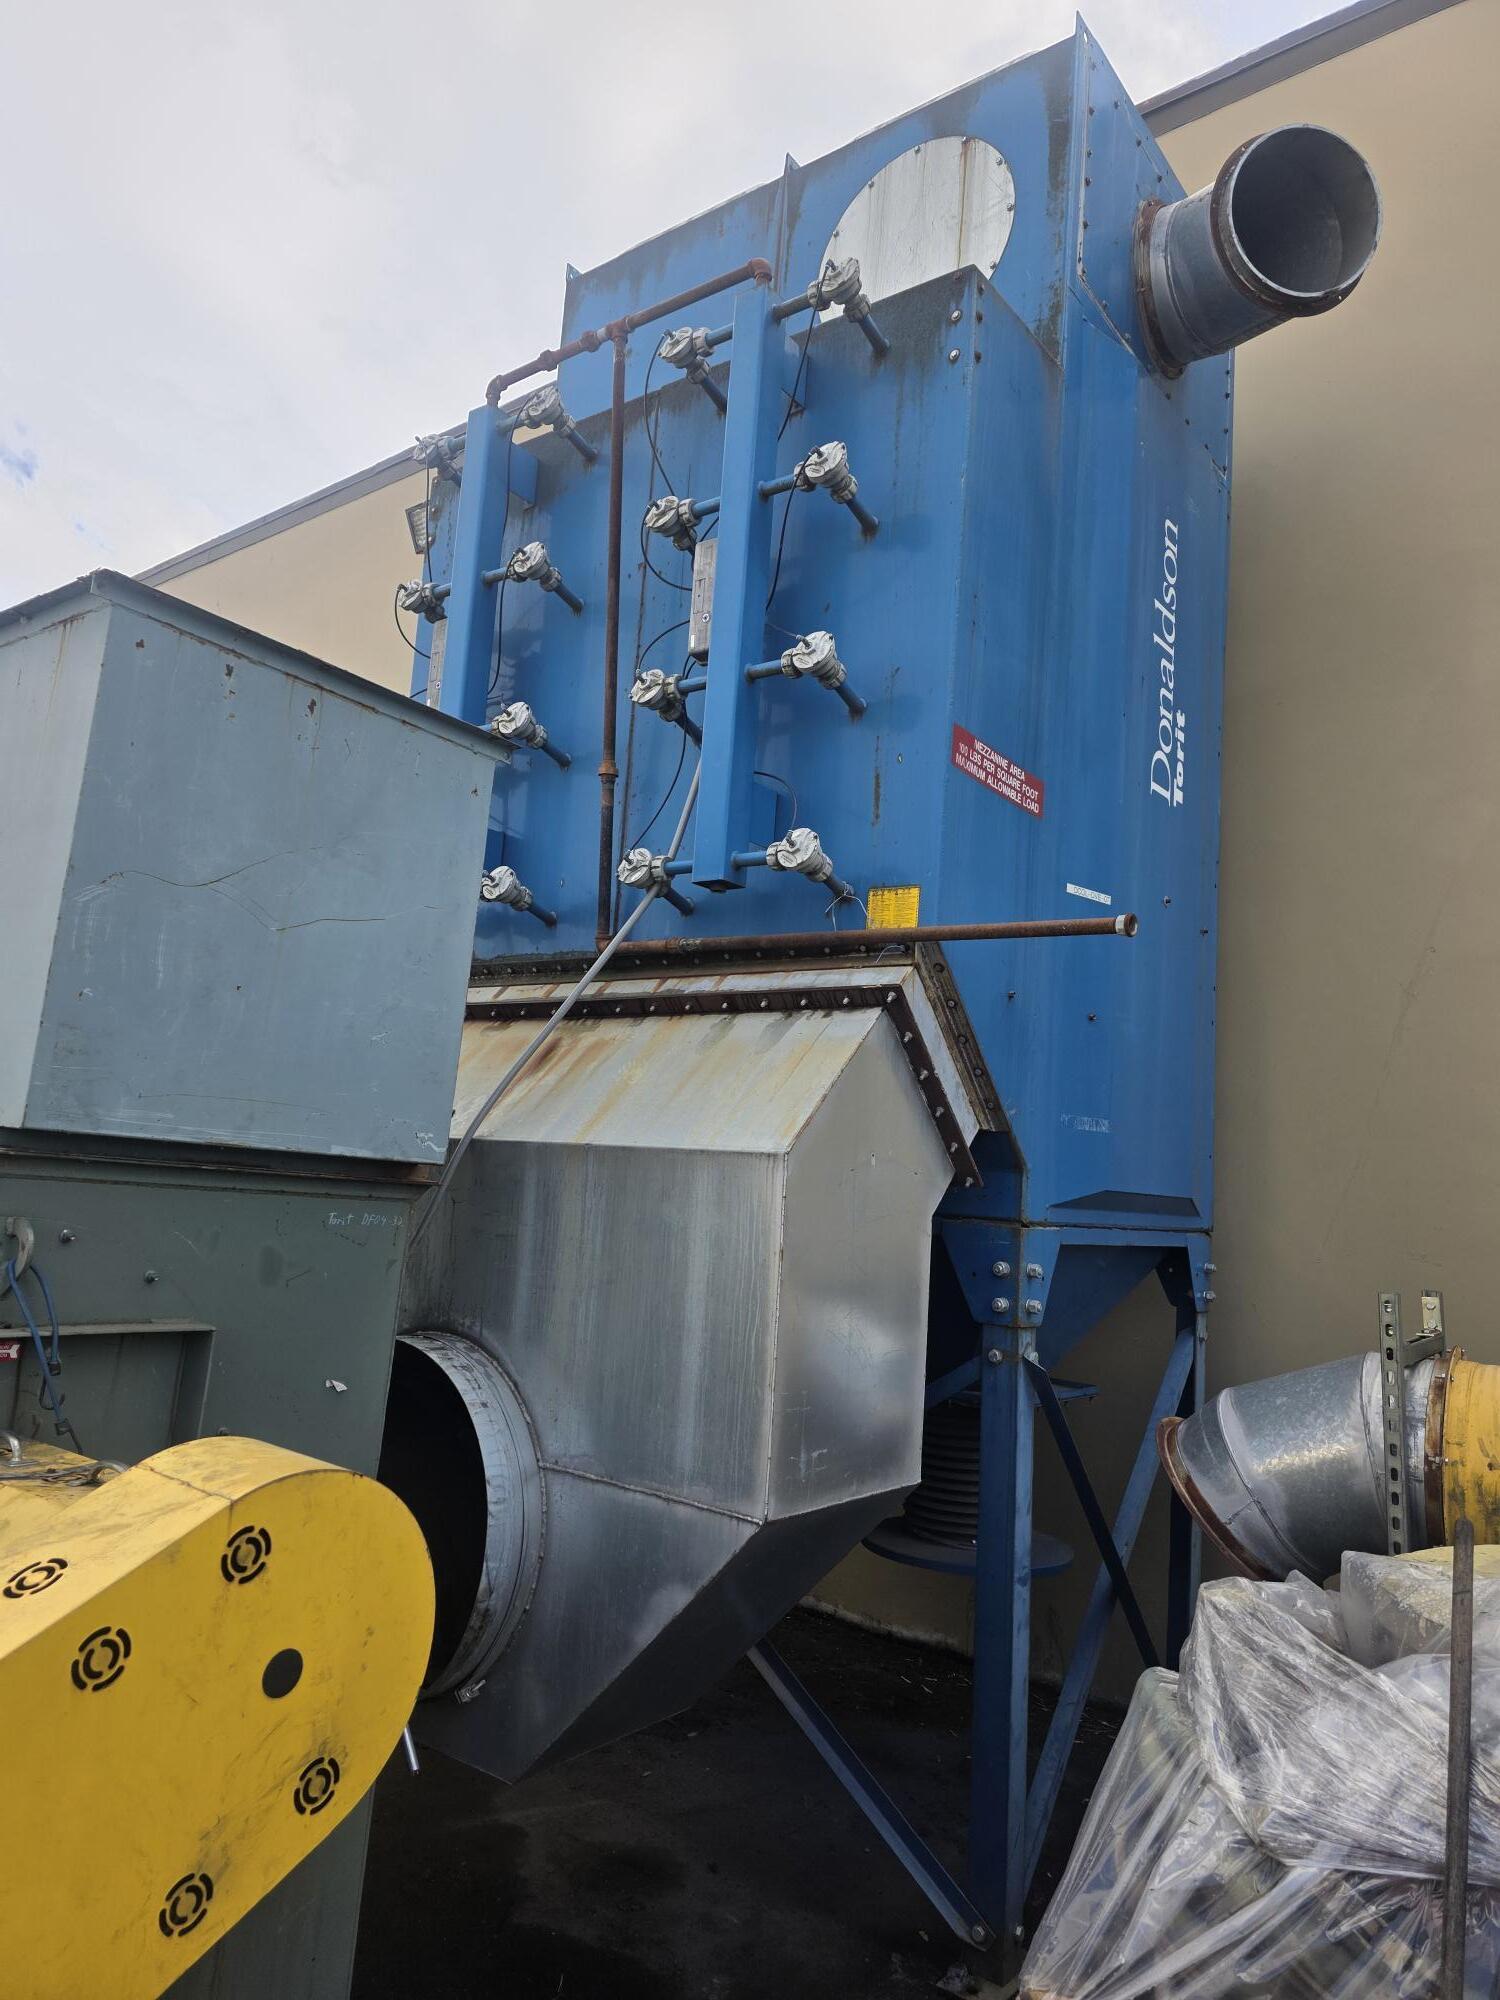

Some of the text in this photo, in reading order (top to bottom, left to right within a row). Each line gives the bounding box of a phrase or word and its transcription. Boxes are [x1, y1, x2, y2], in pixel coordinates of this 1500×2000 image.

[1150, 518, 1178, 808] Donaldson
[956, 753, 1039, 814] MAXIMUM ALLOWABLE LOAD
[969, 749, 981, 766] LBS
[983, 759, 995, 775] PER
[997, 769, 1020, 791] SQUARE
[1022, 784, 1039, 801] FOOT
[975, 739, 1025, 781] MEZZANINE AREA
